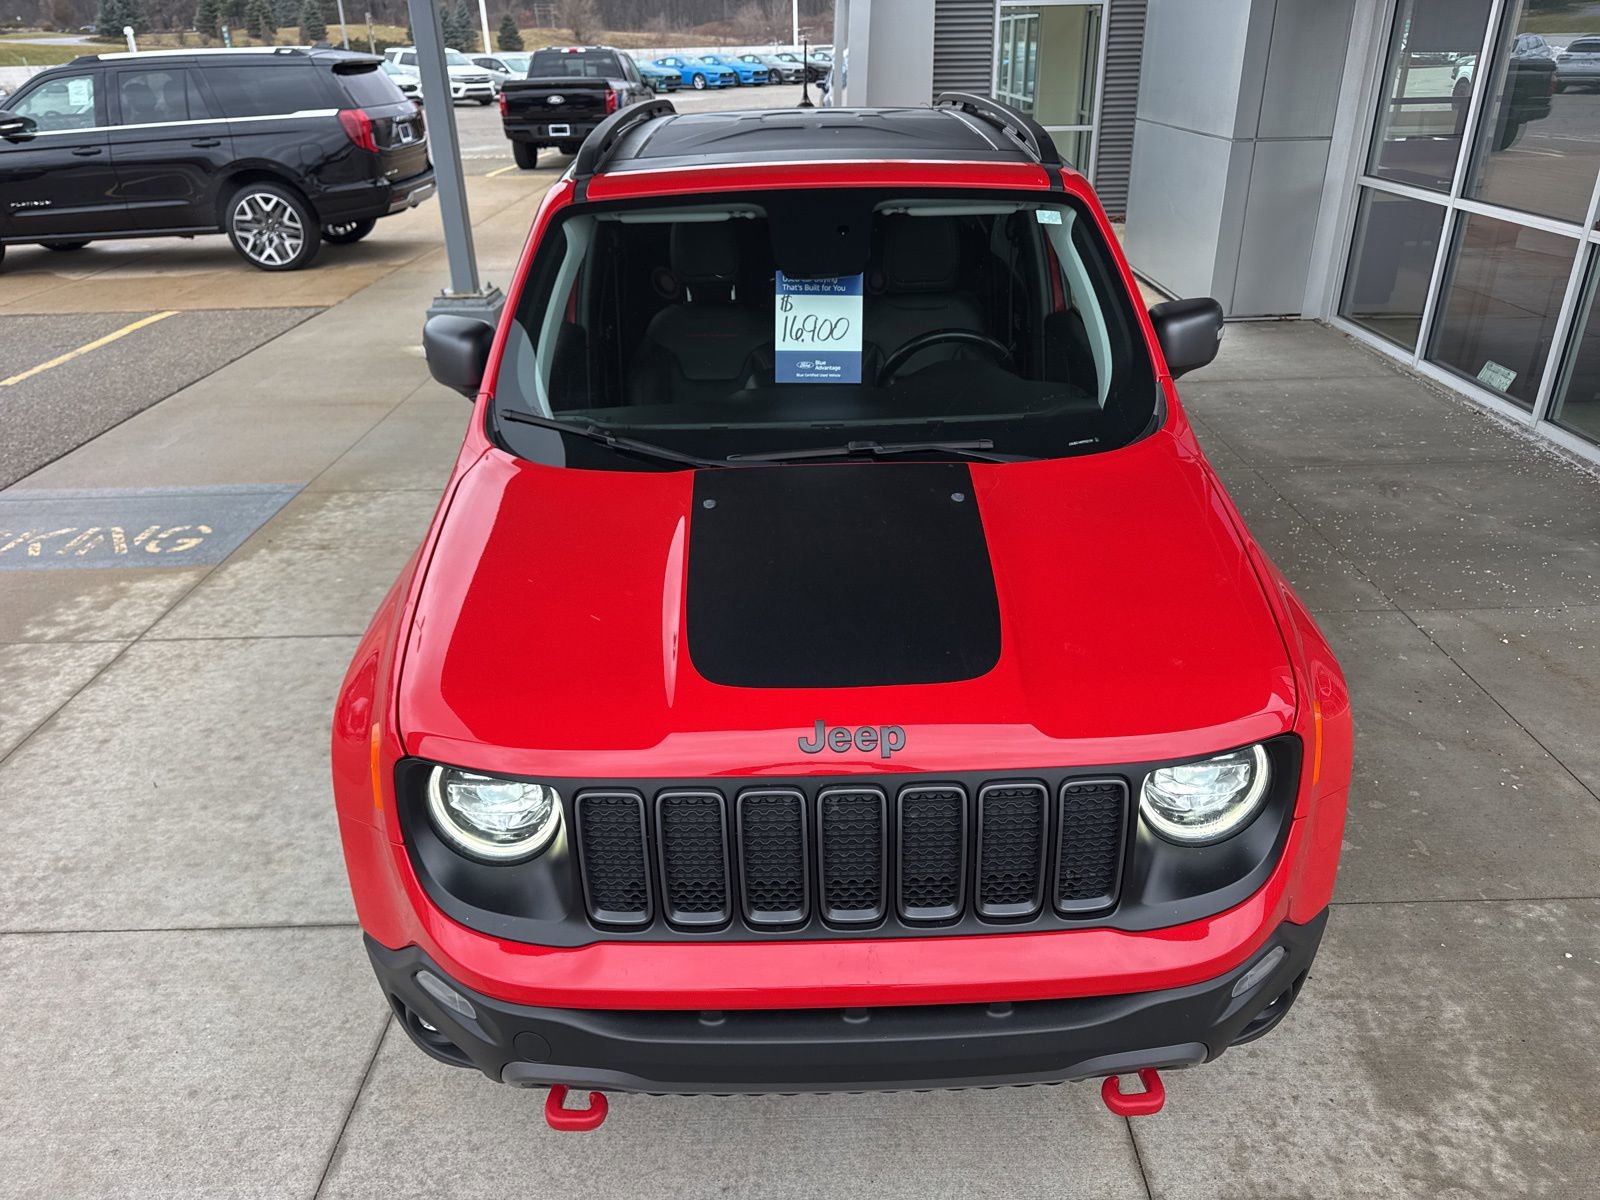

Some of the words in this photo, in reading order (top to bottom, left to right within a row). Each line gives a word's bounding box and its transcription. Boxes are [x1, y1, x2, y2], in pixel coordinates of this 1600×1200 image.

[833, 284, 846, 292] You
[780, 294, 794, 312] $
[798, 719, 906, 759] Jeep
